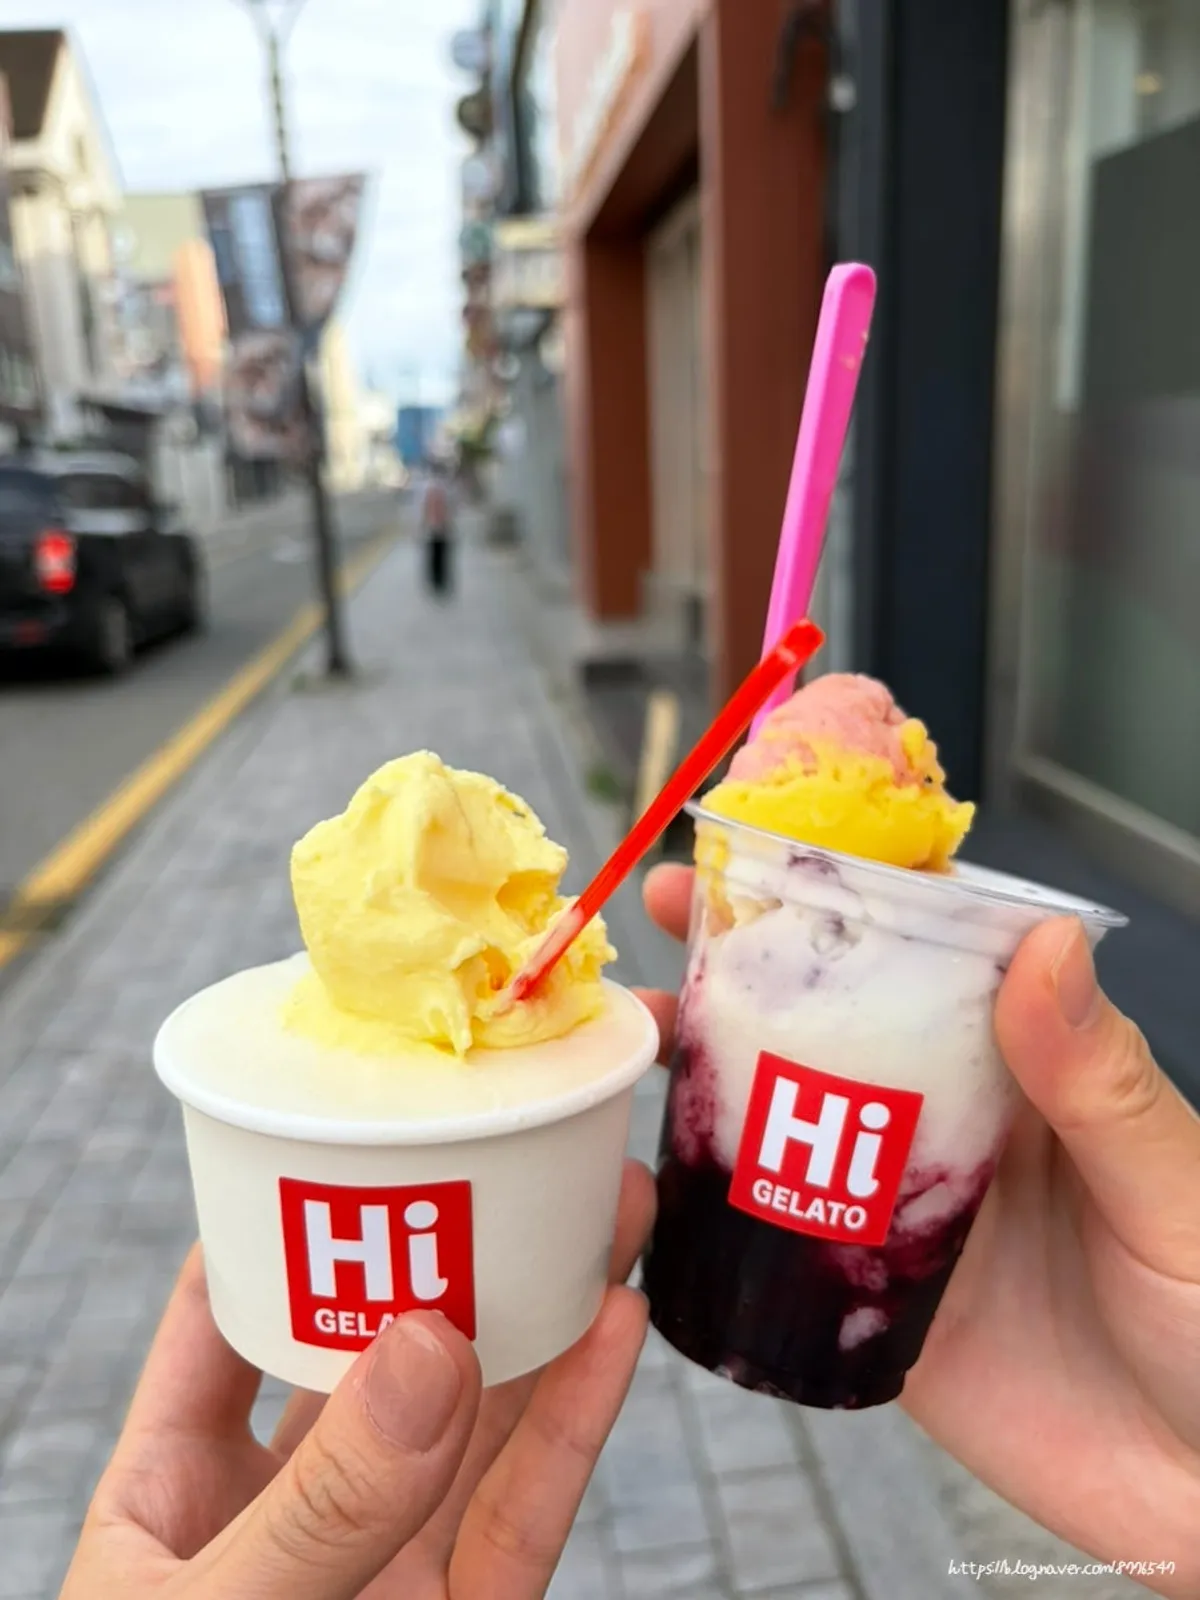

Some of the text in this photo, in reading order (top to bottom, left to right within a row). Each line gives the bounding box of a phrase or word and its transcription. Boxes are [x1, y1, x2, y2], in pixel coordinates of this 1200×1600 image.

[757, 1075, 891, 1198] Hi
[752, 1179, 867, 1230] GELATO
[303, 1199, 448, 1300] Hi
[313, 1308, 403, 1337] GELA
